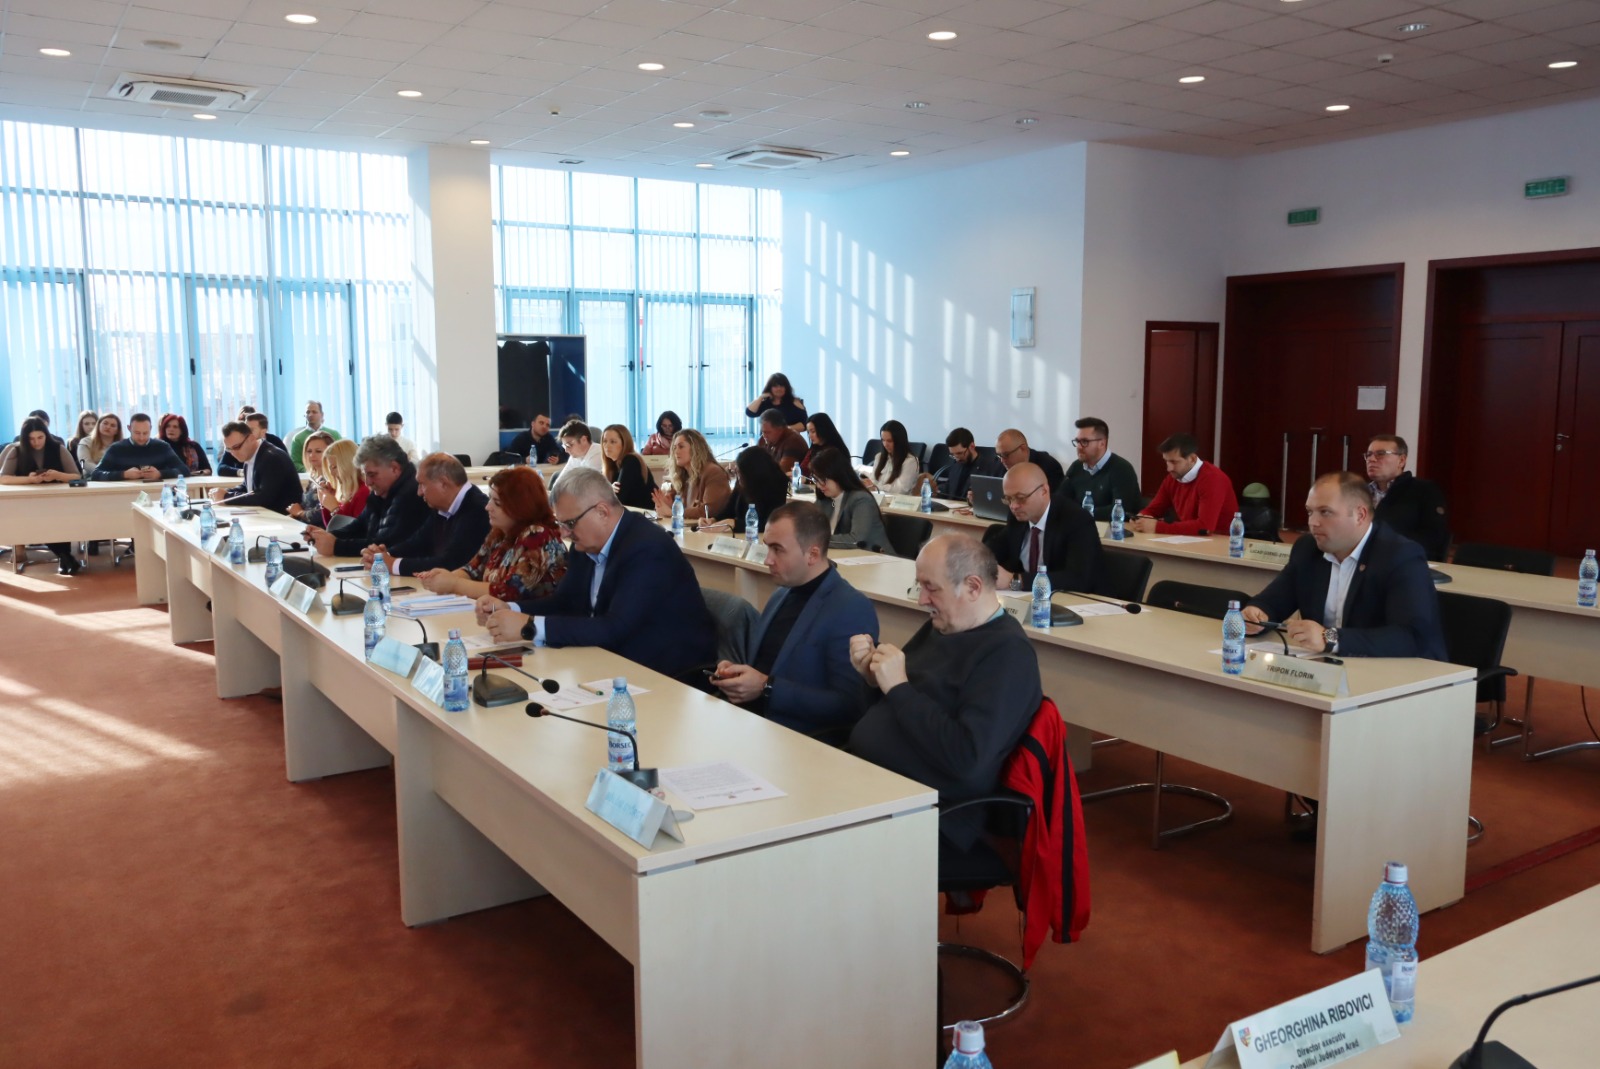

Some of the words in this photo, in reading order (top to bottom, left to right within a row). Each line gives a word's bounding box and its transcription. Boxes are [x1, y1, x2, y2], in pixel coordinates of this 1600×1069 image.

[1266, 664, 1290, 675] TRIPON
[1290, 669, 1315, 680] FLORIN
[1254, 1012, 1328, 1053] GHEORGHINA
[1328, 993, 1374, 1024] RIBOVICI
[1296, 1042, 1321, 1058] Director
[1321, 1031, 1346, 1048] executiv
[1345, 1038, 1360, 1050] Arad
